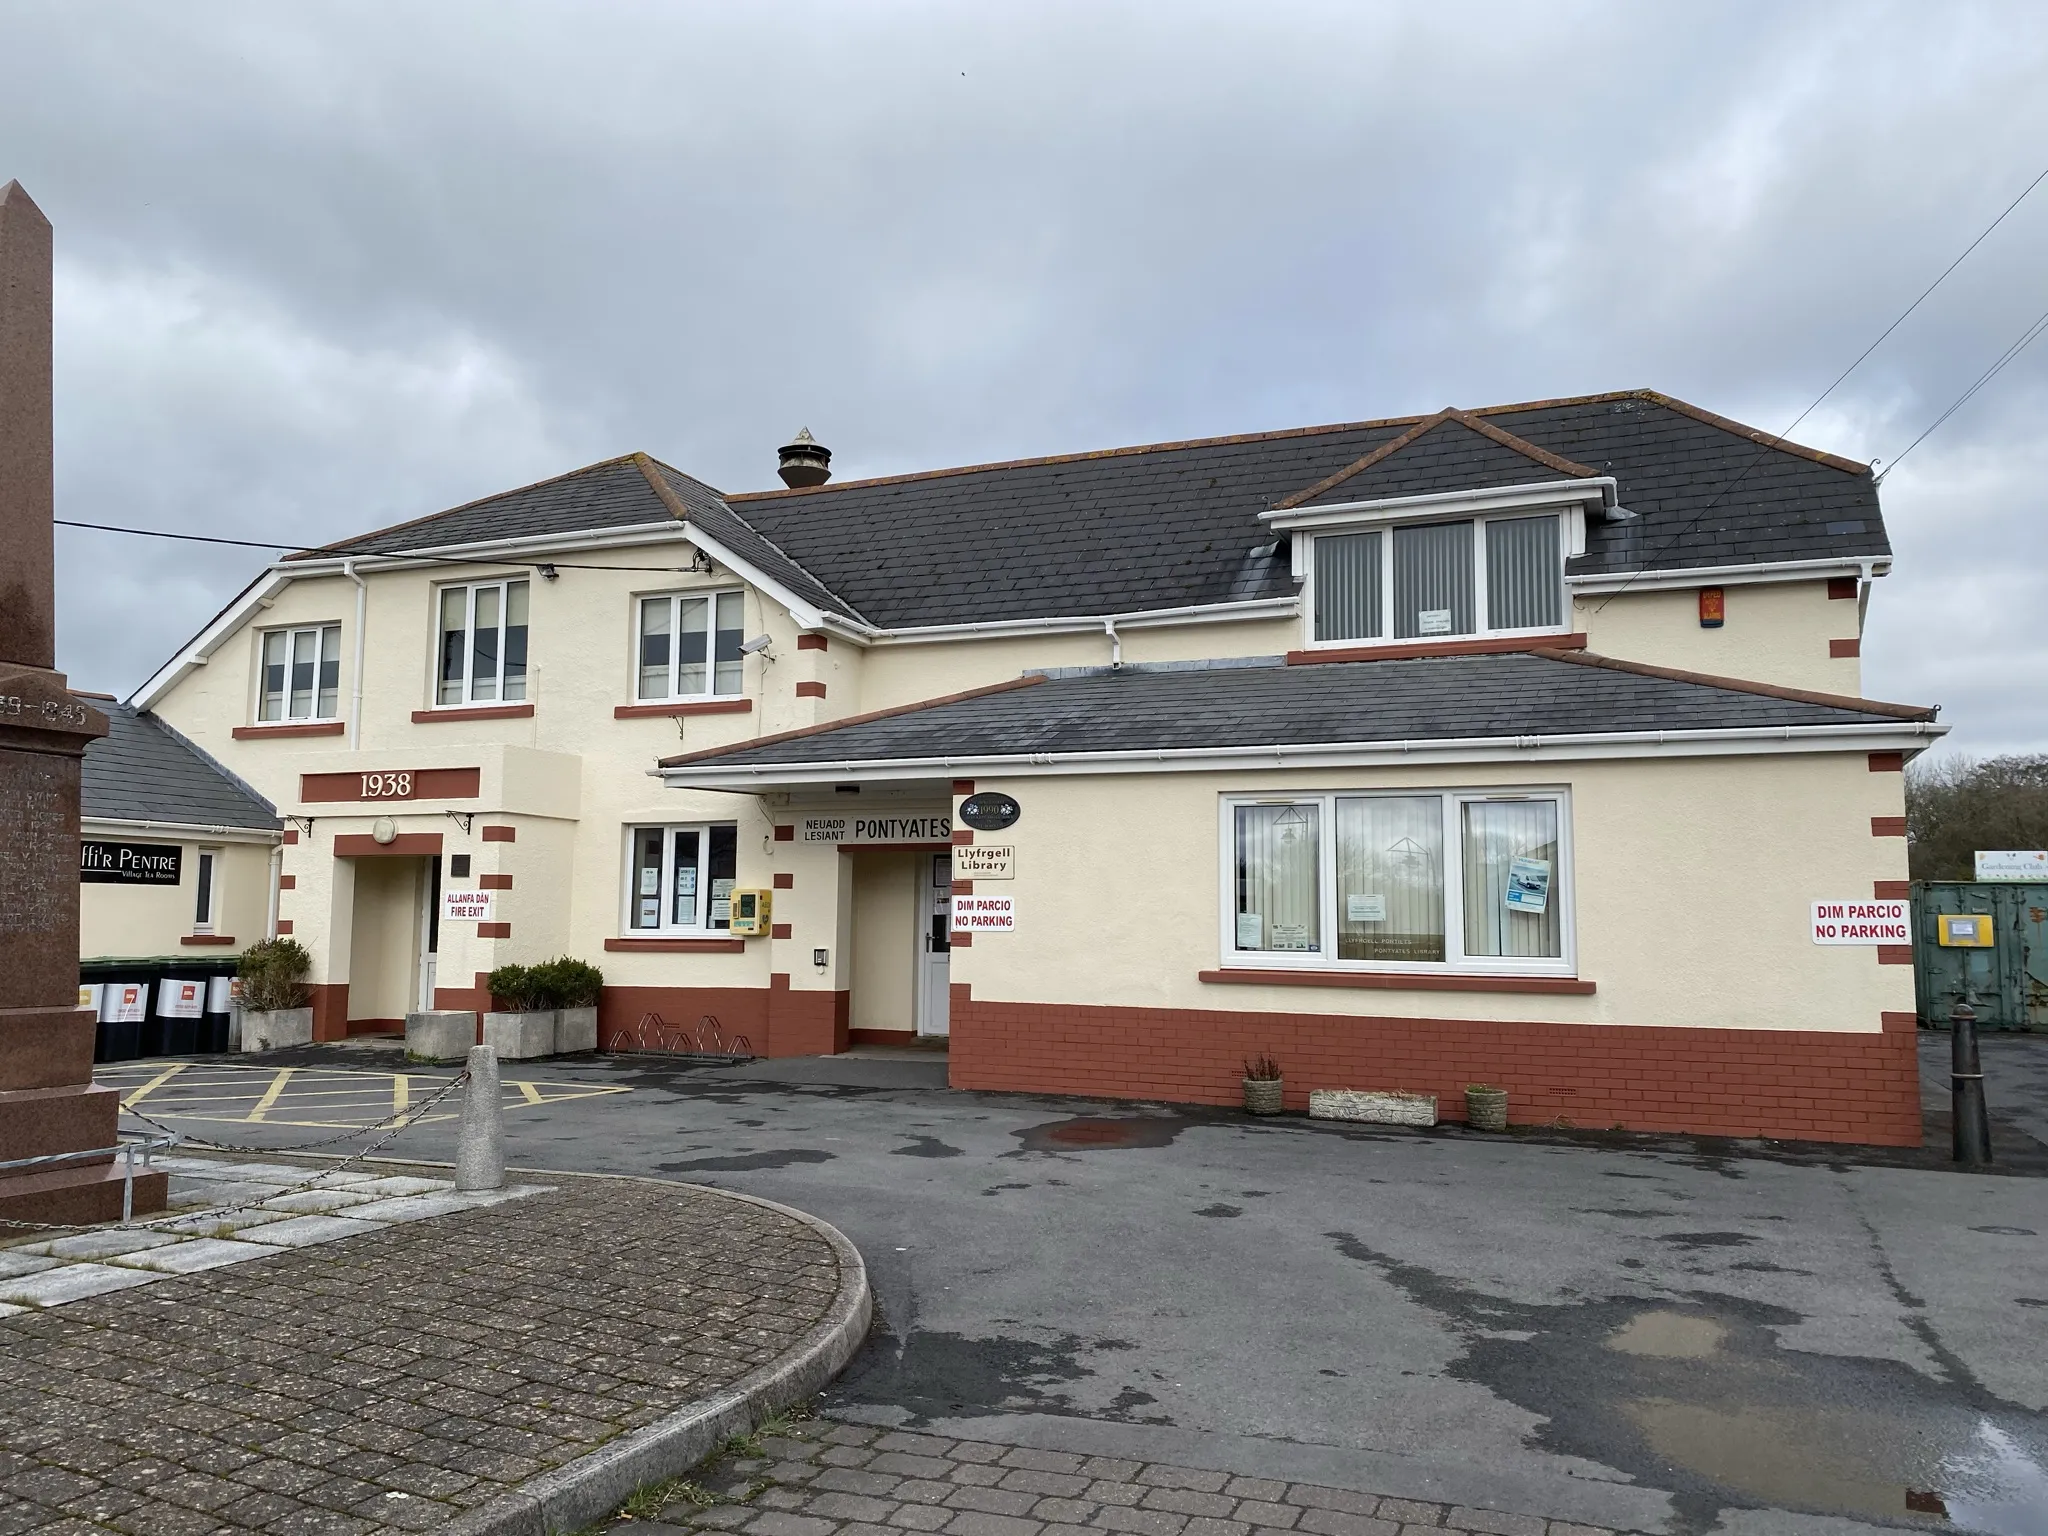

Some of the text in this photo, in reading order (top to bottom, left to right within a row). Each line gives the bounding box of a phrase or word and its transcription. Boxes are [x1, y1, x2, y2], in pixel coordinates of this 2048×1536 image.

[360, 774, 411, 797] 1938
[806, 819, 845, 830] NEUADD
[855, 818, 951, 839] PONTYATES
[804, 831, 846, 841] LESIANT
[119, 848, 177, 871] PENTRE
[957, 848, 1011, 860] Llyfrgell
[961, 860, 1007, 871] Library
[1981, 862, 2043, 870] Gardening Club
[155, 872, 176, 880] Rooms
[447, 892, 475, 904] ALLANFA
[957, 900, 1011, 911] DIM PARCIO
[451, 906, 485, 917] FIRE EXIT
[1817, 905, 1902, 919] DIM PARCIO
[955, 915, 1012, 926] NO PARKING
[1816, 924, 1906, 938] NO PARKING
